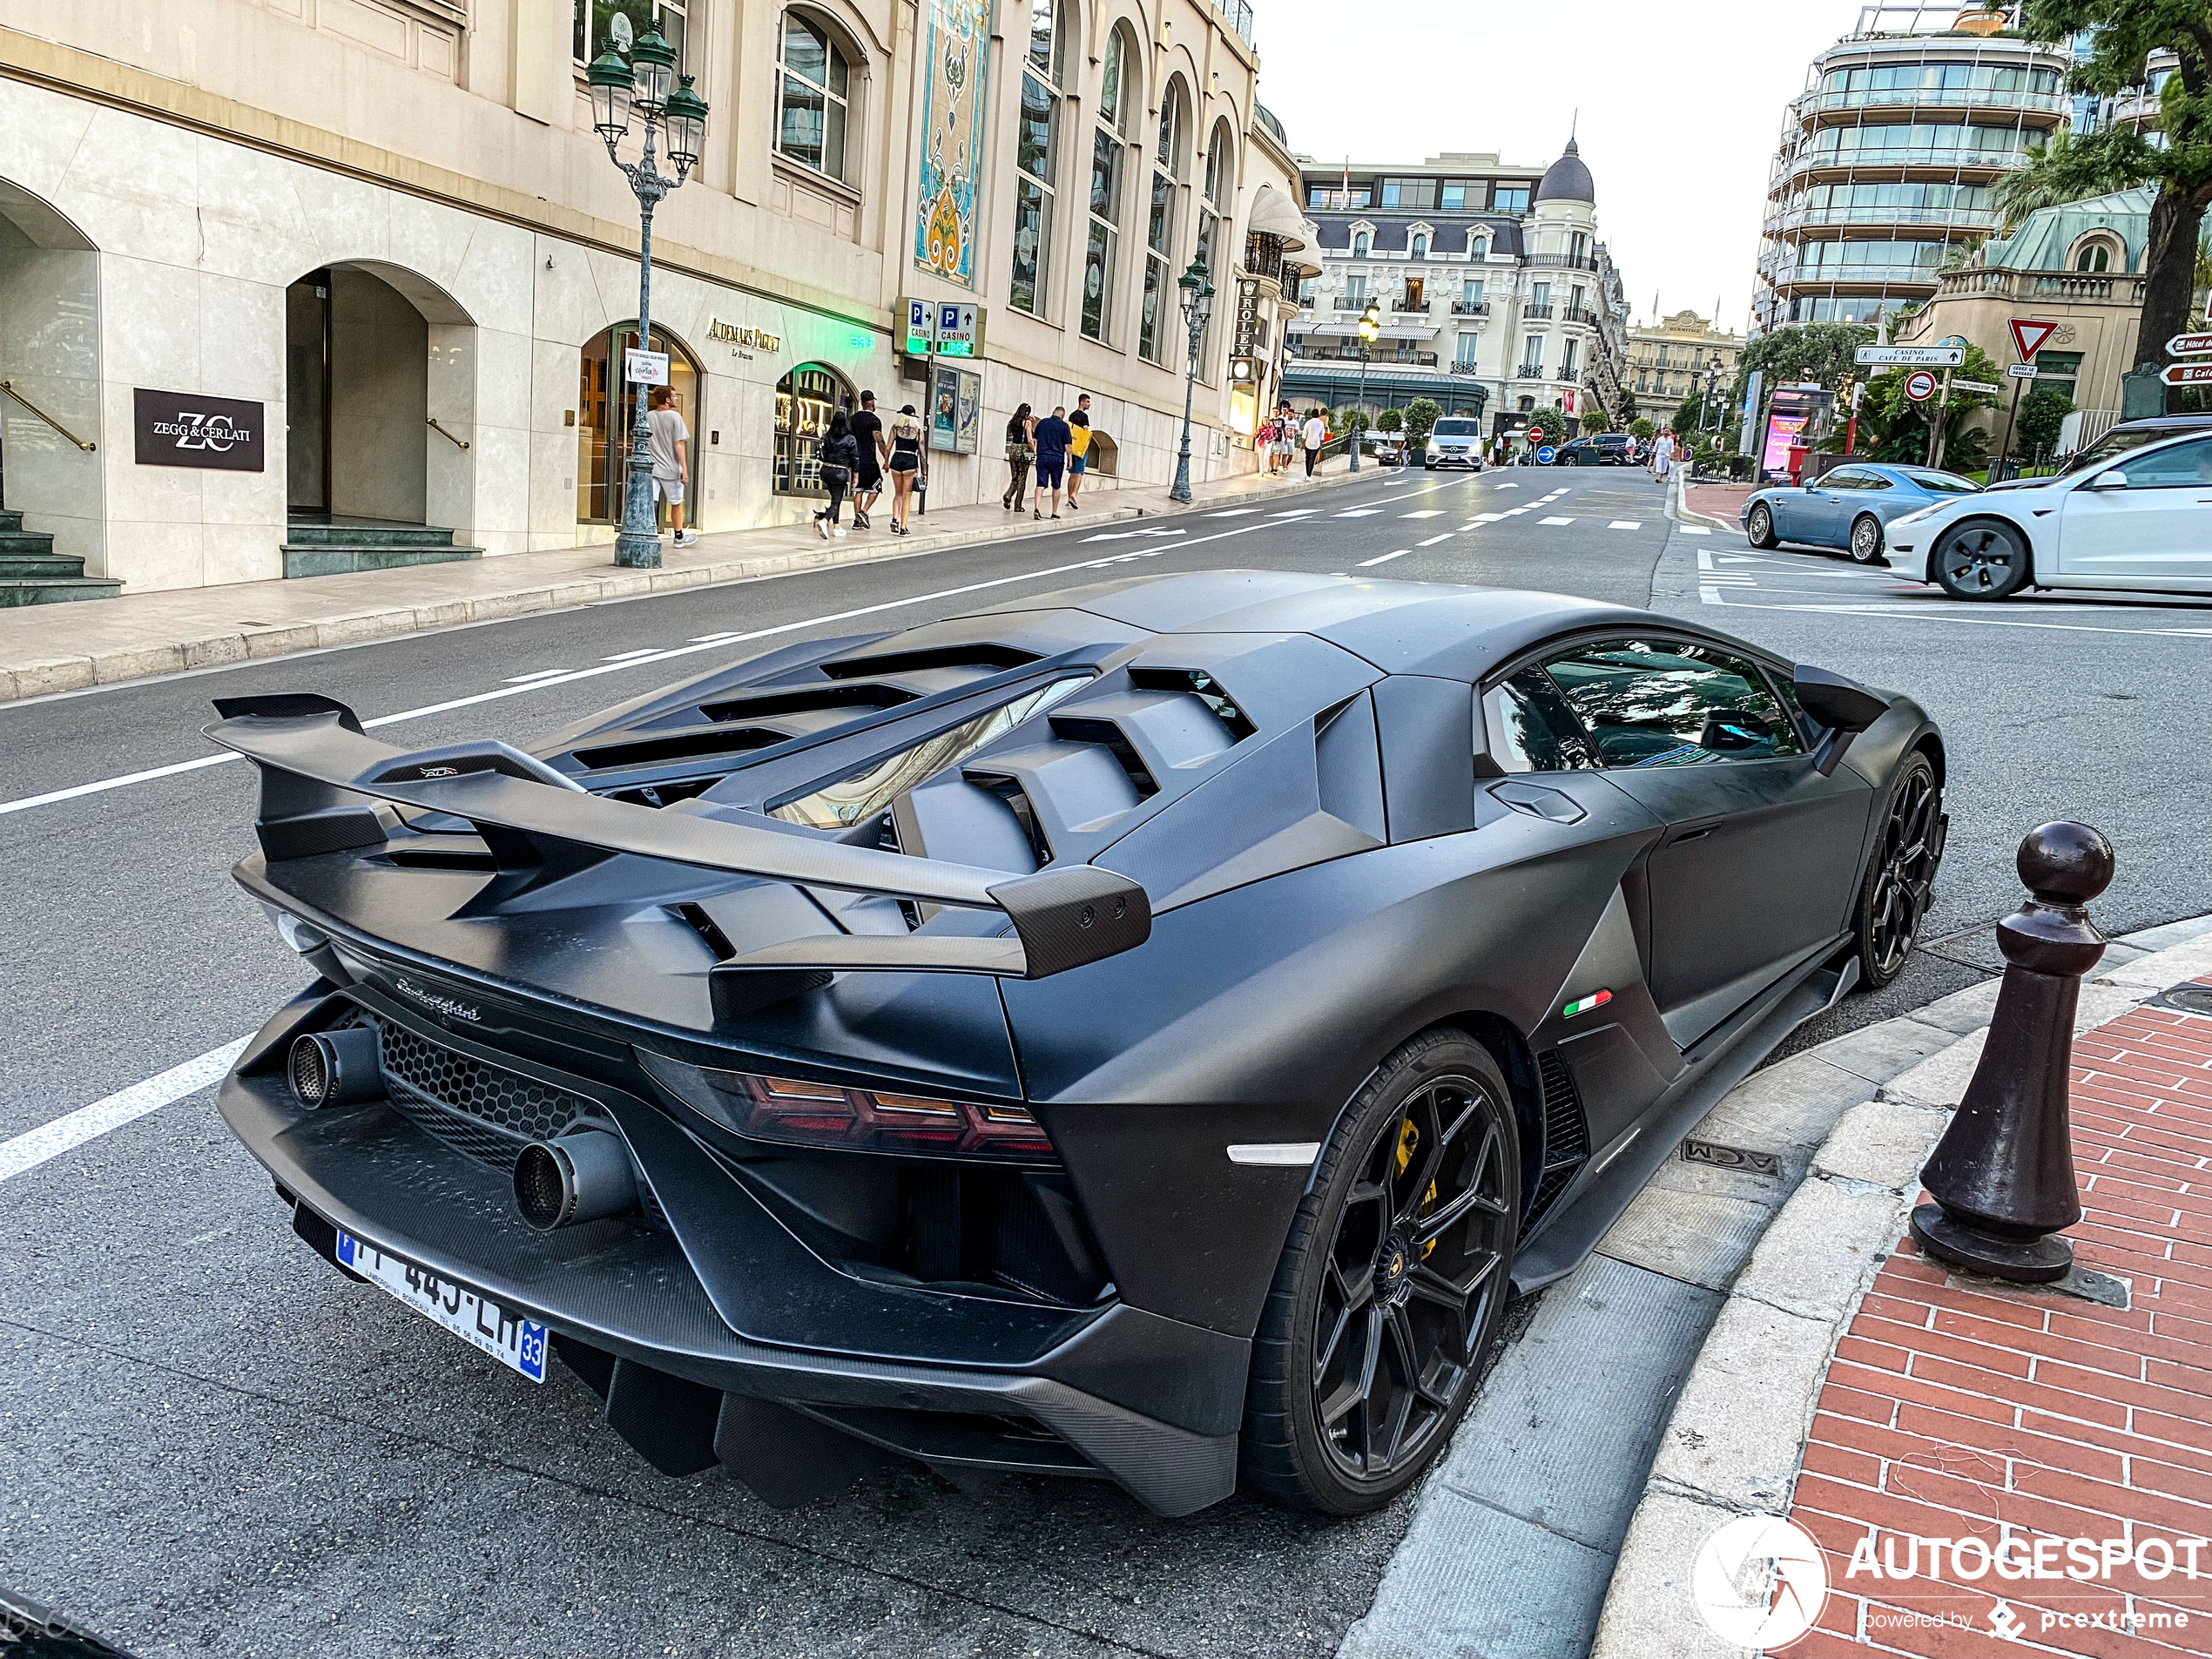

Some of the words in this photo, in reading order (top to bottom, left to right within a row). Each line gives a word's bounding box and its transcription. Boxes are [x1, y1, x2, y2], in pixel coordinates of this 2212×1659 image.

[911, 327, 930, 339] CASINO
[941, 331, 970, 341] CASINO
[1238, 298, 1253, 356] ROLEX
[941, 341, 971, 355] LIBRE
[2186, 339, 2205, 348] Hôtel
[153, 421, 188, 435] ZEGG
[200, 426, 250, 442] CERLATI
[395, 977, 482, 1022] Lamborghini
[401, 1293, 429, 1315] BORDEAUX
[439, 1314, 449, 1327] TEL
[496, 1348, 504, 1359] 74
[523, 1333, 543, 1366] 33
